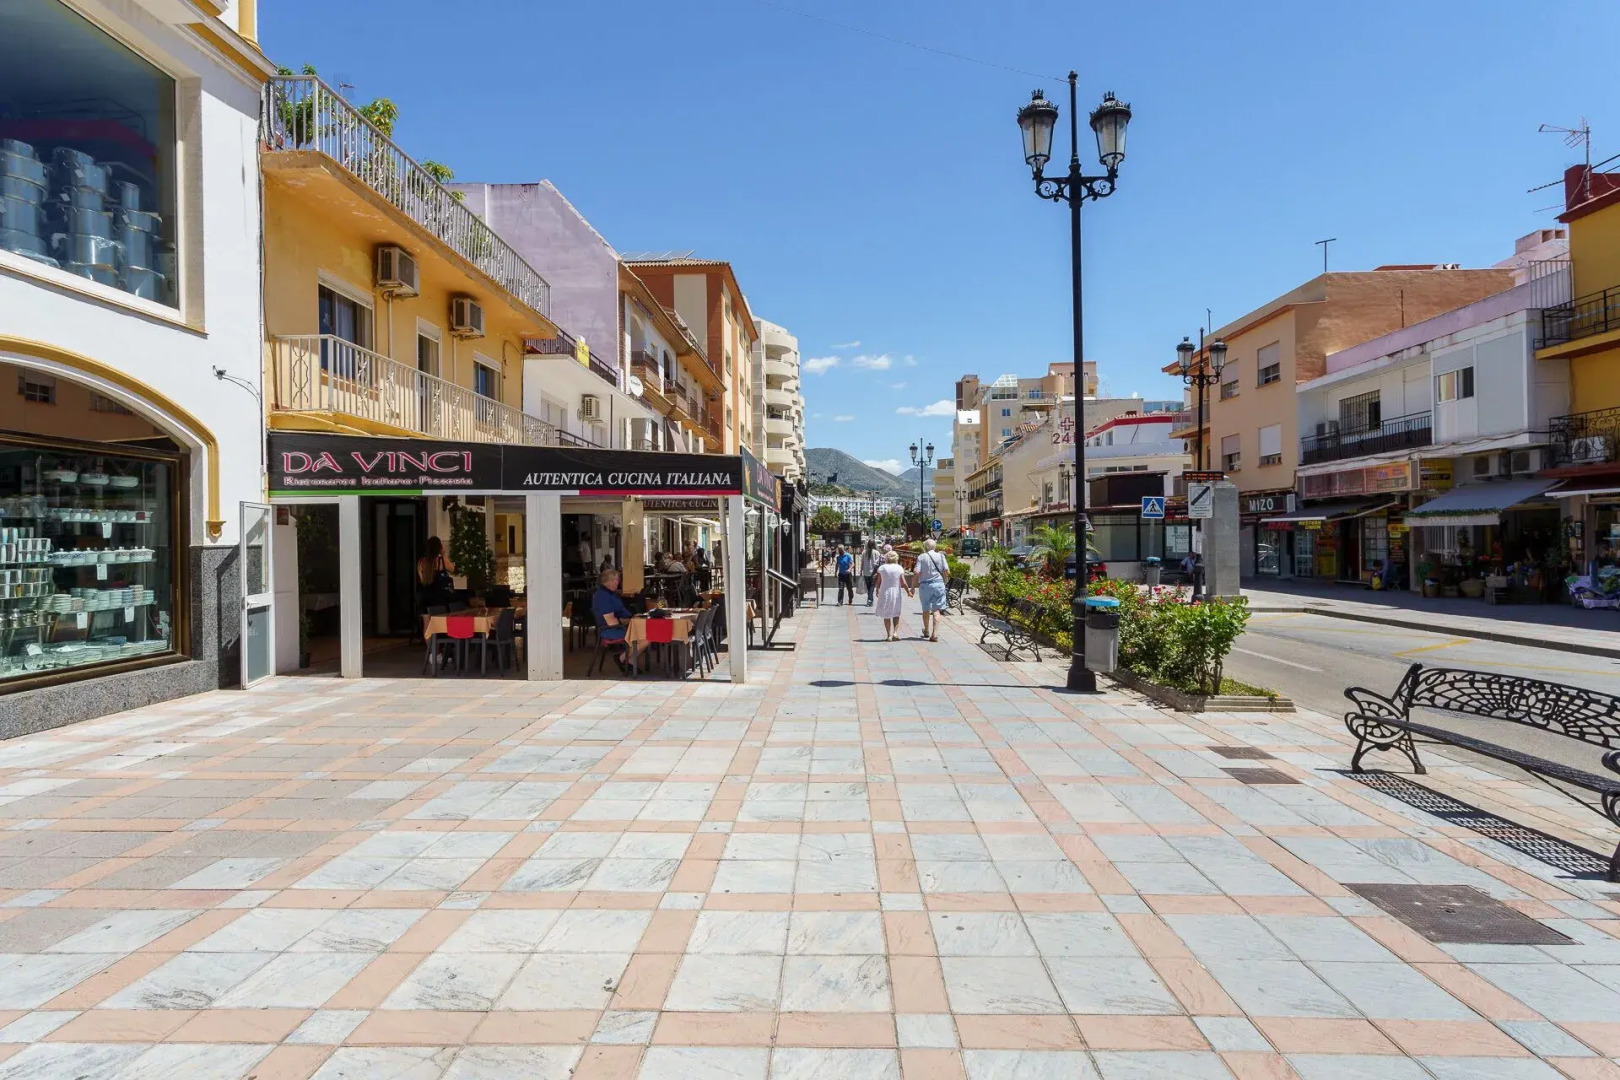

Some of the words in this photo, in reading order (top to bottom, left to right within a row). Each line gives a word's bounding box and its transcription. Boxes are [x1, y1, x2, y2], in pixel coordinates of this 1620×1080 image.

[1052, 432, 1076, 445] 24
[282, 451, 343, 473] DA
[351, 451, 473, 473] VINCI
[522, 472, 603, 486] AUTENTICA
[607, 472, 662, 486] CUCINA
[666, 472, 732, 486] ITALIANA
[643, 499, 687, 508] UTENTICA
[688, 499, 719, 508] CUCIN
[1249, 498, 1274, 512] MIZO
